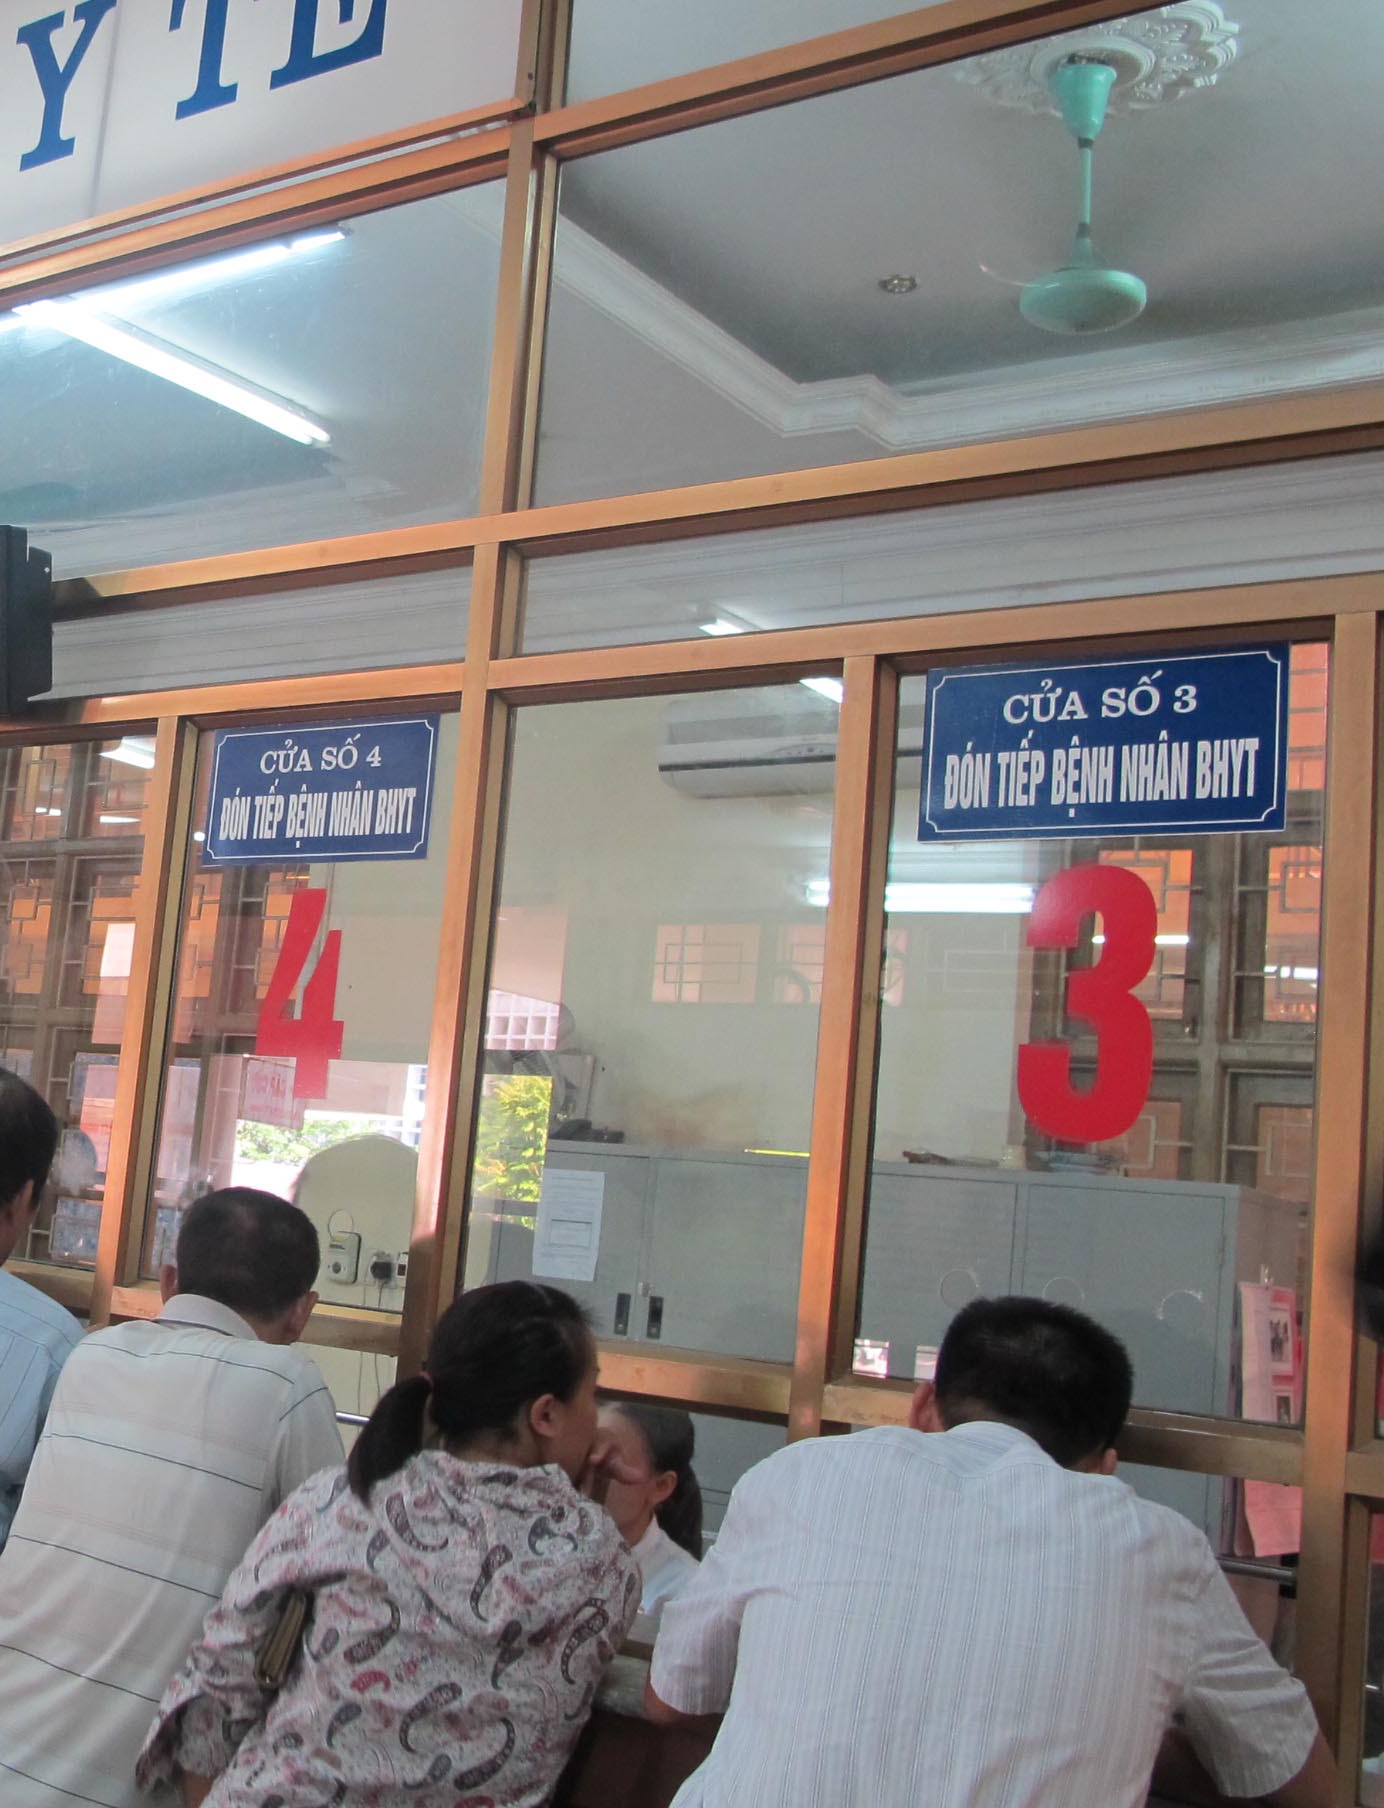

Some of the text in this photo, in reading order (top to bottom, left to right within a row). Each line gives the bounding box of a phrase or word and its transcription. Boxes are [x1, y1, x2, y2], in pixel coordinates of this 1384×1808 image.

[16, 0, 118, 172] Y
[1003, 670, 1197, 724] CỬA SỐ 3
[260, 733, 382, 774] CỬA SỐ 4
[944, 730, 1259, 818] ĐÓN TIẾP BỆNH NHÂN BHYT
[219, 779, 416, 848] ĐÓN TIẾP BỆNH NHÂN BHYT
[255, 888, 344, 1099] 4
[1017, 863, 1157, 1143] 3
